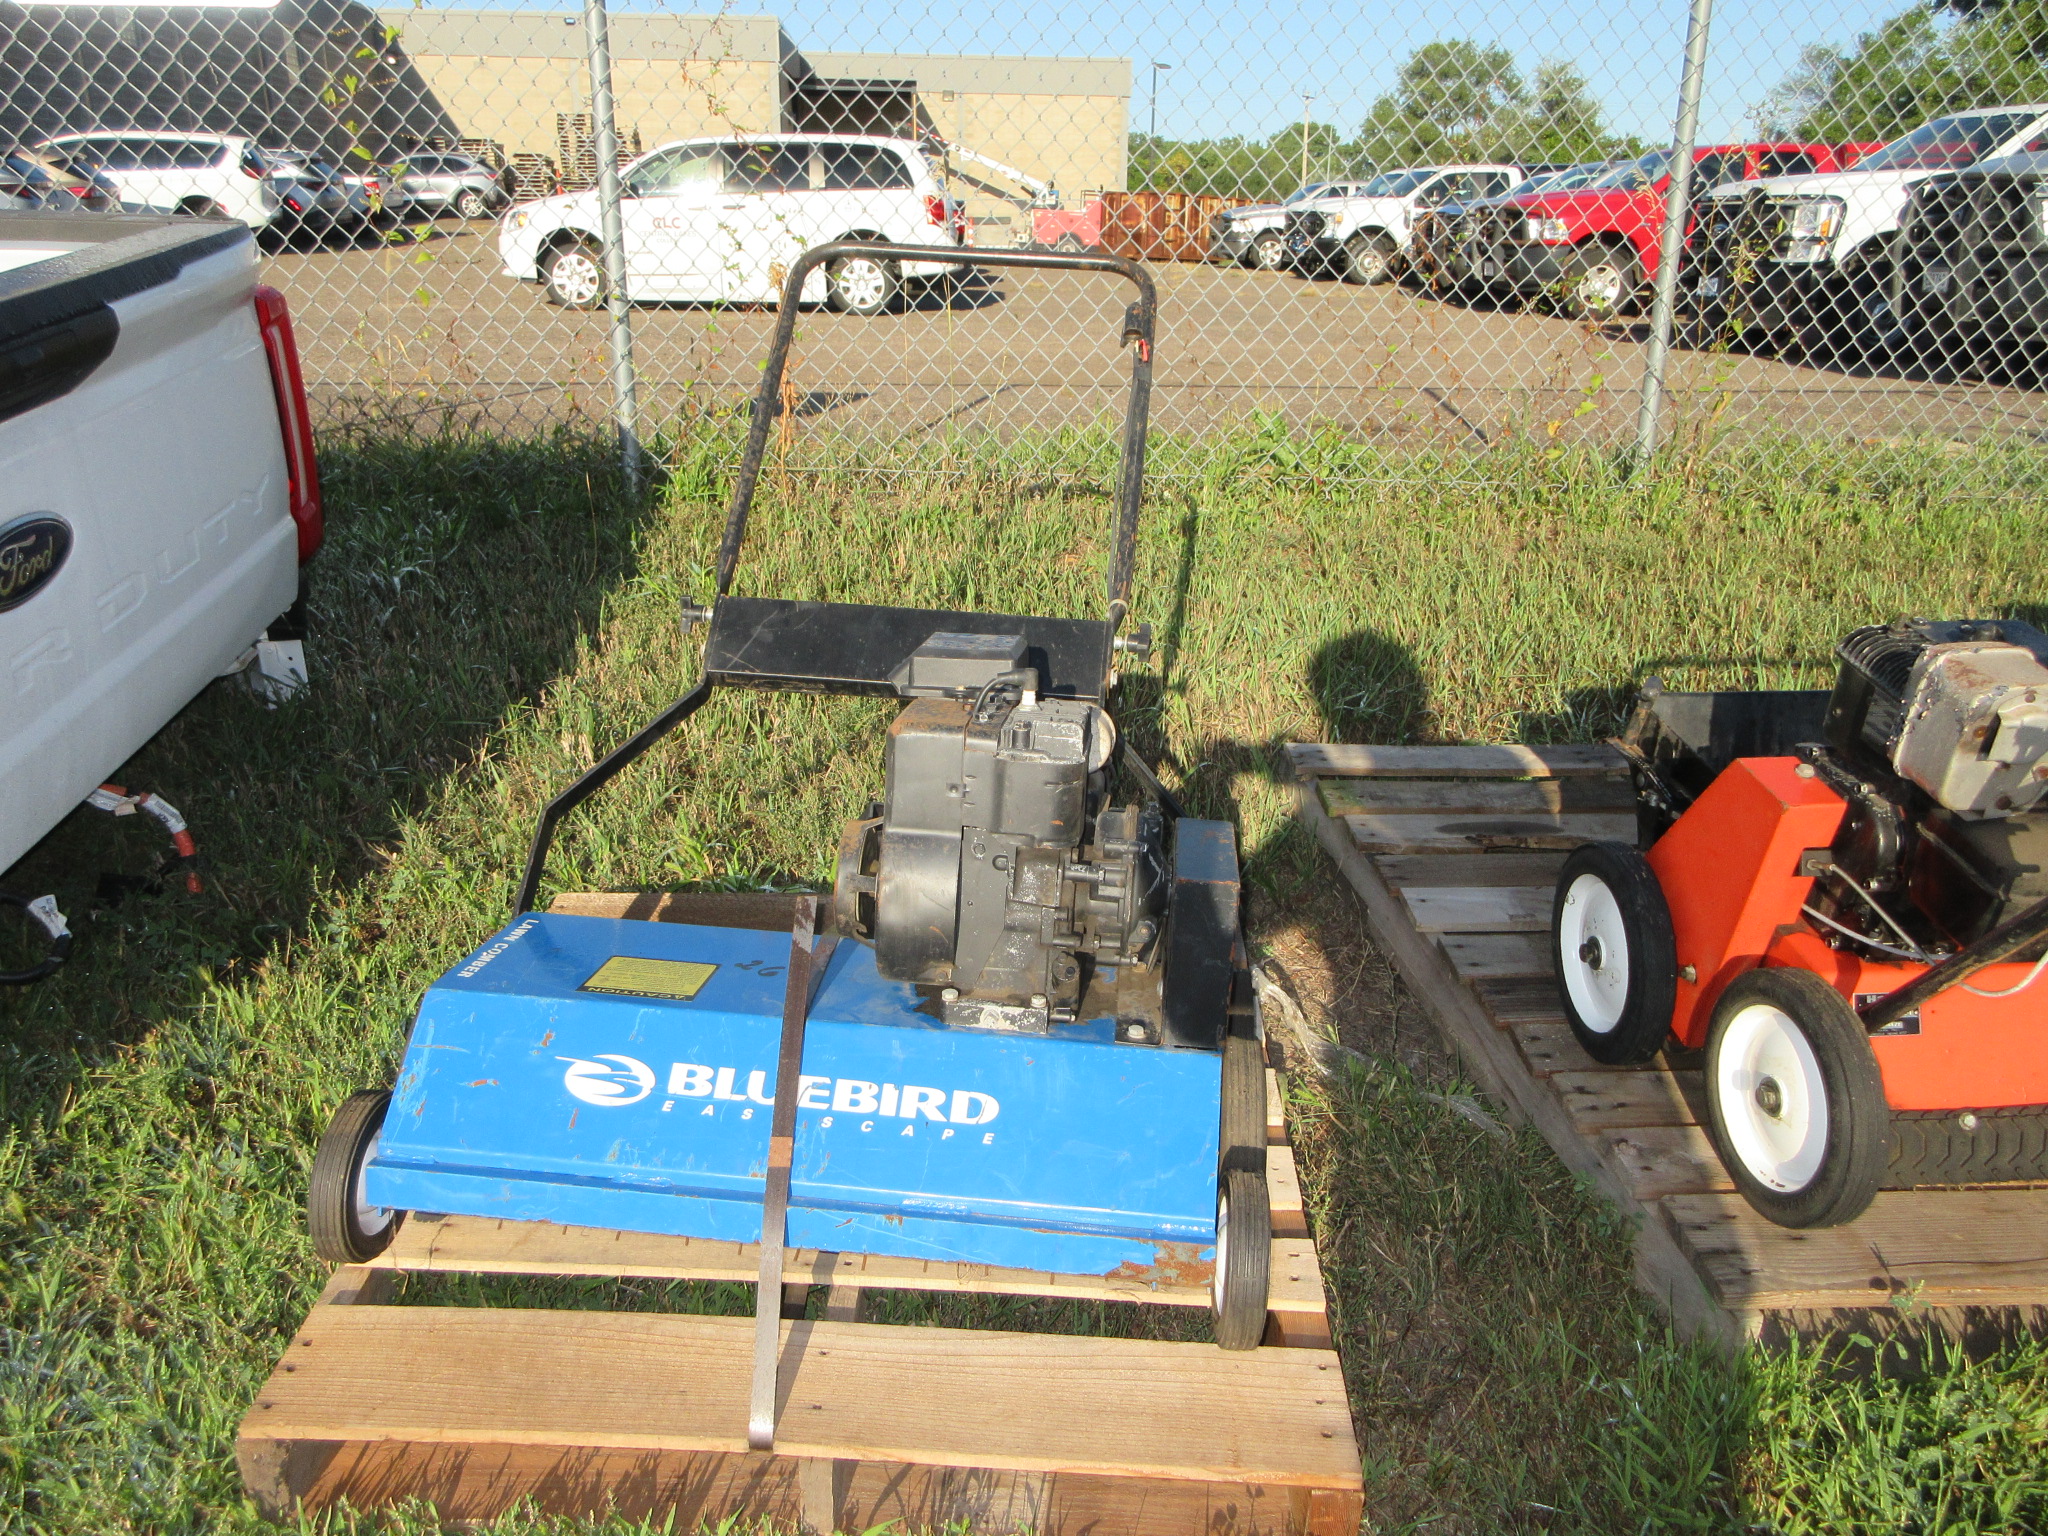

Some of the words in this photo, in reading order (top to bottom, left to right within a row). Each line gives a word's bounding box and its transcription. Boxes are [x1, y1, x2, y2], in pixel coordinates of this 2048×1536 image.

[652, 216, 682, 229] CLC
[0, 533, 54, 597] Ford
[97, 472, 270, 634] DUTY
[503, 918, 540, 942] LAWN
[456, 942, 509, 978] COMBER
[587, 986, 670, 999] CAUTION
[667, 1062, 1000, 1125] BLUEBIRD
